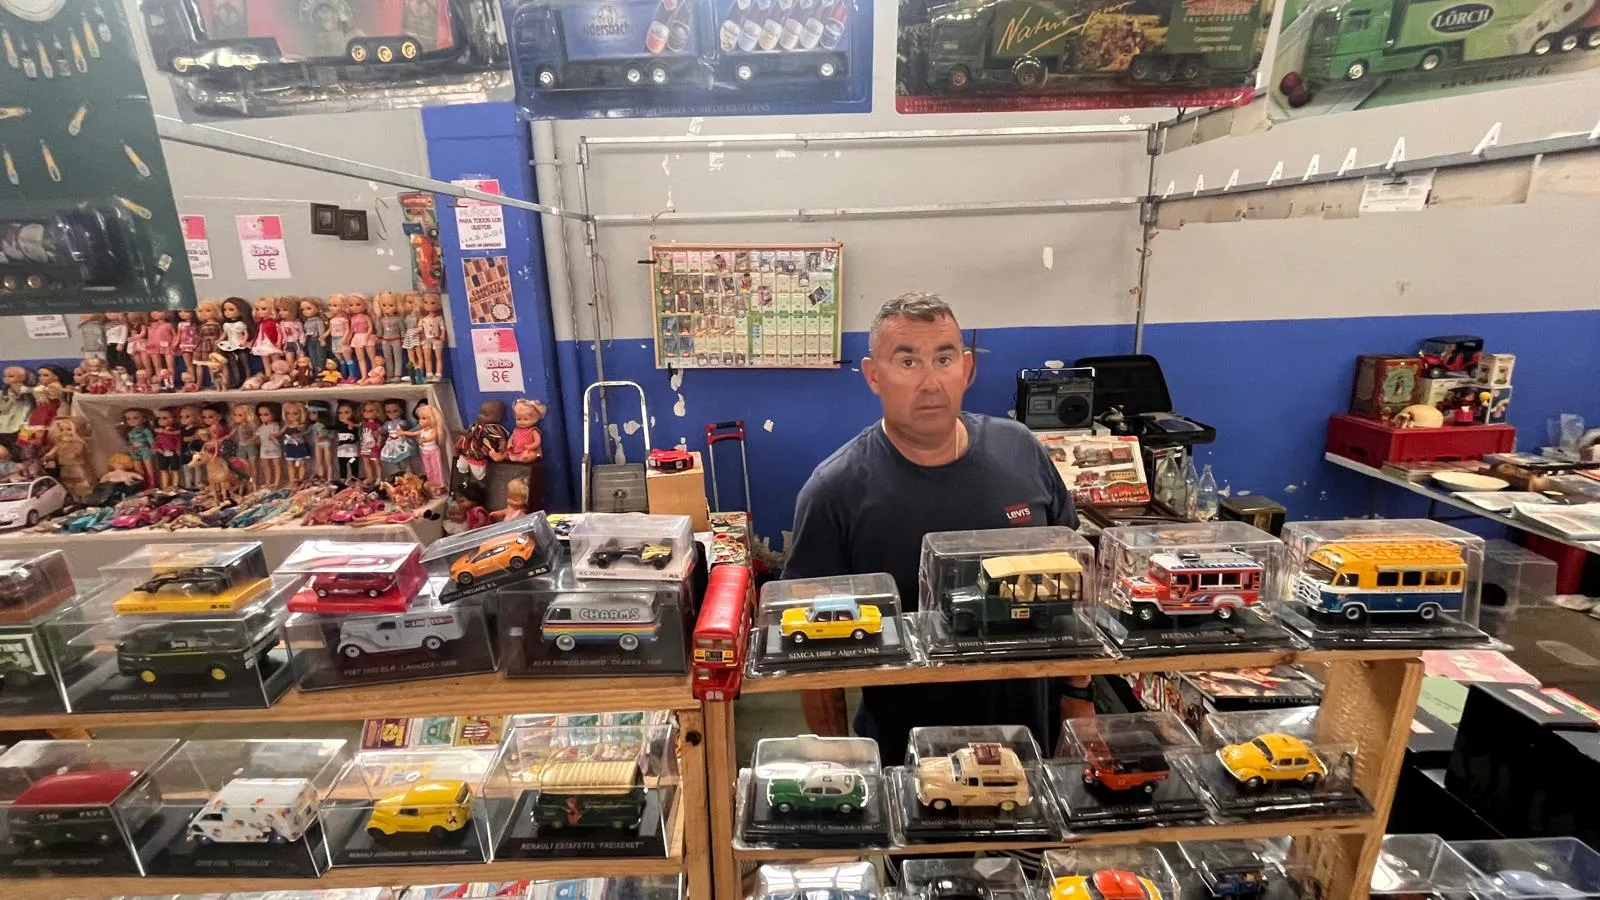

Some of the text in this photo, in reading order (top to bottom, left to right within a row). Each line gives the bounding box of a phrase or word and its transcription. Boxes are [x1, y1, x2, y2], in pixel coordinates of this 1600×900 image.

[1435, 9, 1490, 28] LÖRCH
[258, 258, 277, 271] 8€
[492, 370, 510, 383] 8€
[579, 607, 640, 620] CHARMS
[789, 651, 815, 660] SIMCA
[838, 649, 857, 657] Alger
[863, 647, 879, 655] 1962
[79, 810, 105, 818] PEPE
[520, 840, 645, 850] RENAULT ESTAFETTE "FREIXENET"
